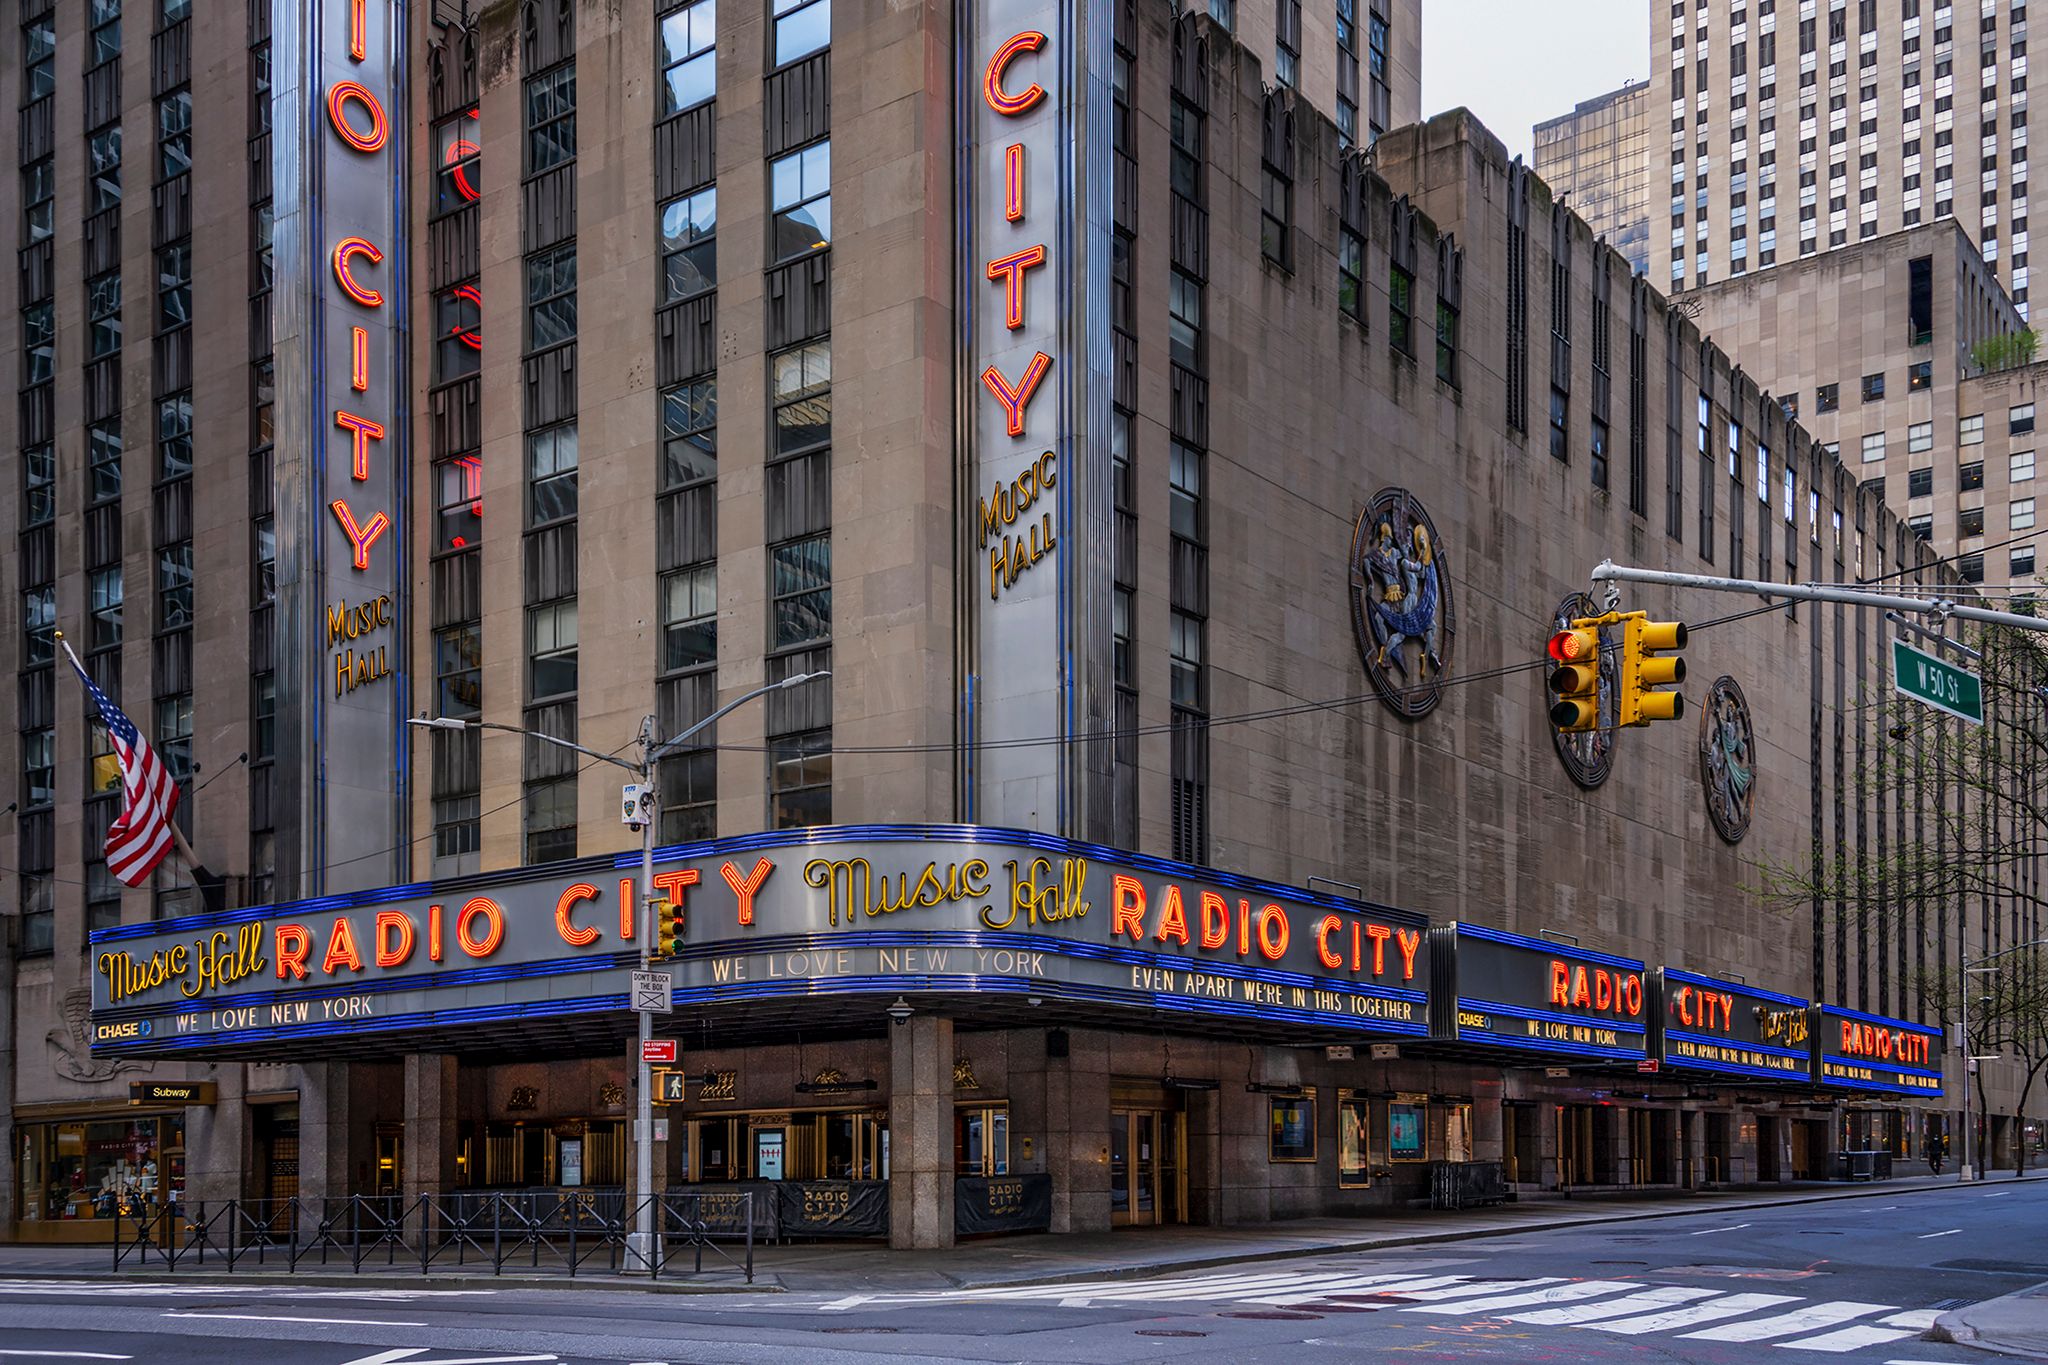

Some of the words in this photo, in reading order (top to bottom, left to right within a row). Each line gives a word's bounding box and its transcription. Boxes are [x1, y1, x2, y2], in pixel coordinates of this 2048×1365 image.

[984, 30, 1053, 438] CITY
[333, 236, 390, 571] CITY
[980, 450, 1056, 549] MUSIC
[990, 512, 1056, 600] HALL
[327, 595, 390, 650] MUSIC
[335, 645, 390, 698] HALL
[1917, 661, 1926, 690] W
[1930, 667, 1944, 698] 50
[1948, 674, 1960, 704] St
[804, 857, 990, 926] Music
[980, 857, 1091, 930] Hall
[99, 945, 188, 1002] Music
[180, 920, 267, 997] Hall
[276, 897, 504, 981] RADIO
[555, 857, 776, 946] CITY
[1112, 873, 1290, 960] RADIO
[1317, 913, 1420, 980] CITY
[634, 973, 650, 981] DON'T
[651, 974, 670, 982] BLOCK
[712, 957, 746, 982] WE
[769, 950, 851, 977] LOVE
[879, 948, 949, 974] NEW
[976, 950, 1044, 976] YORK
[1132, 966, 1174, 991] EVEN
[1185, 974, 1234, 998] APART
[1243, 981, 1284, 1005] WE'RE
[1292, 988, 1306, 1007] IN
[1313, 990, 1342, 1012] THIS
[1350, 997, 1412, 1020] TOGETHER
[1551, 960, 1642, 1016] RADIO
[1678, 985, 1733, 1032] CITY
[98, 1022, 139, 1039] CHASE
[176, 1013, 198, 1032] WE
[212, 1007, 257, 1029] LOVE
[271, 1002, 309, 1025] NEW
[323, 995, 372, 1019] YORK
[1458, 1012, 1485, 1028] CHASE
[1527, 1020, 1540, 1036] WE
[1546, 1021, 1568, 1040] LOVE
[1573, 1026, 1591, 1043] NEW
[1595, 1029, 1616, 1046] YORK
[1677, 1041, 1696, 1056] EVEN
[1698, 1044, 1718, 1060] APART
[1742, 1051, 1749, 1064] IN
[1751, 1052, 1763, 1066] THIS
[1841, 1020, 1892, 1059] RADIO
[1897, 1032, 1930, 1064] CITY
[153, 1087, 190, 1099] Subway
[804, 1191, 849, 1201] RADIO
[805, 1202, 848, 1211] CITY
[989, 1184, 1023, 1195] RADIO
[990, 1195, 1022, 1206] CITY
